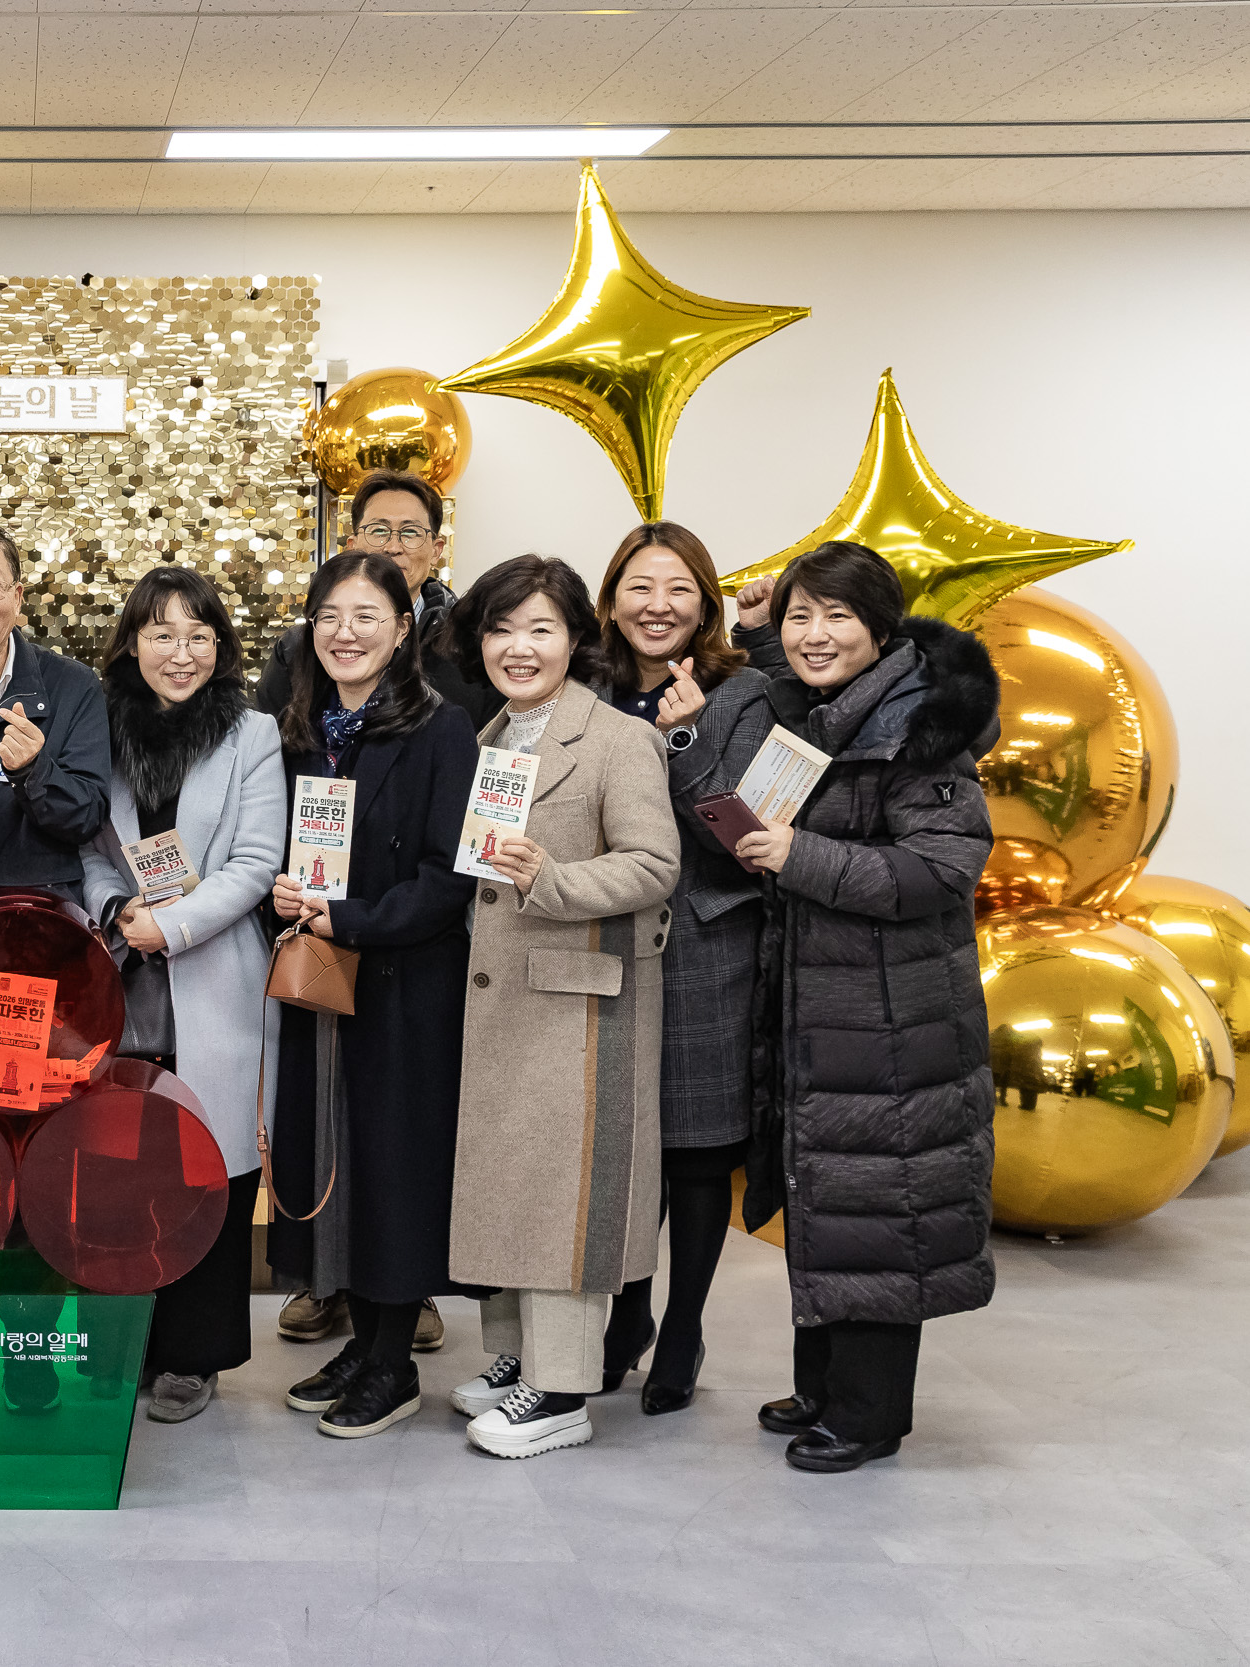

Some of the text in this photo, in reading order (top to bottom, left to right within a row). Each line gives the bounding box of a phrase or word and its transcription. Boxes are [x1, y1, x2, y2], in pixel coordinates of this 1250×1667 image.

[69, 385, 101, 419] 날
[484, 768, 500, 777] 2026
[480, 776, 526, 796] 따뜻한
[477, 790, 522, 808] 겨울나기
[300, 805, 346, 821] 따뜻한
[300, 819, 344, 832] 겨울나기
[136, 850, 180, 871] 따뜻한
[141, 859, 184, 878] 겨울나기
[47, 1332, 87, 1352] 열매
